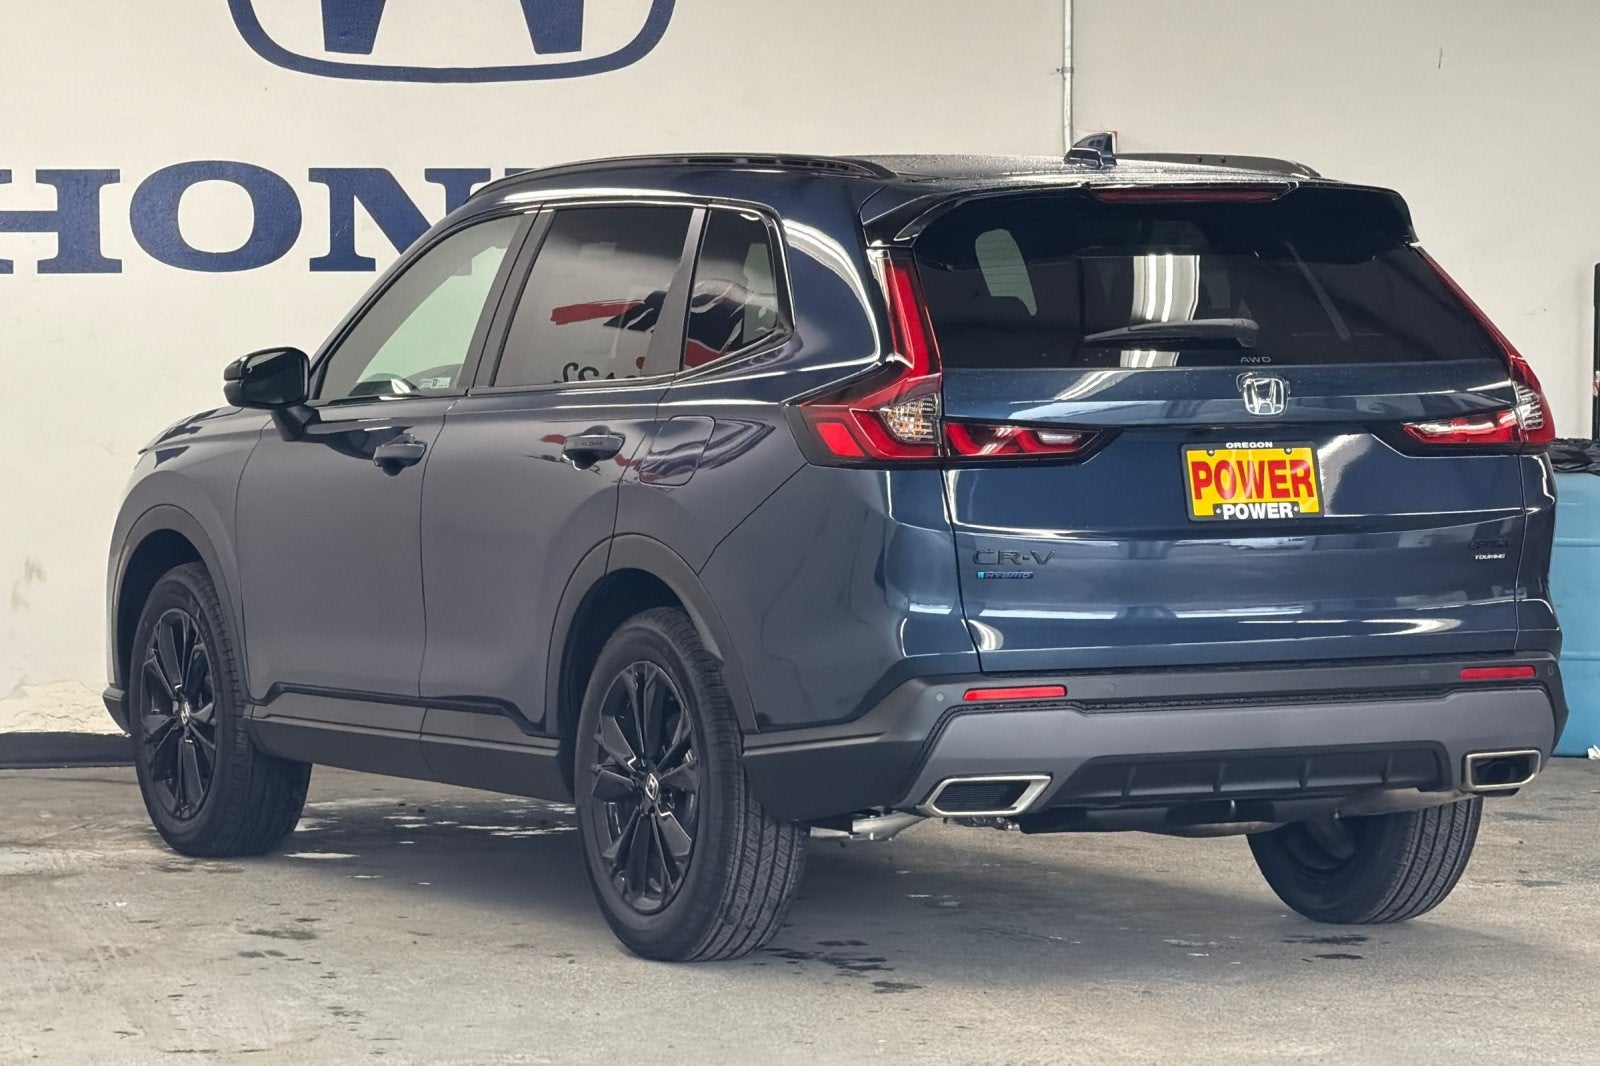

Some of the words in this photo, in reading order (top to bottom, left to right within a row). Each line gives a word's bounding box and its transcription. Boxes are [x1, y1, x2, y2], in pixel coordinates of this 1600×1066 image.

[0, 160, 550, 273] HON
[1225, 441, 1273, 449] OREGON
[1191, 459, 1315, 500] POWER
[1222, 502, 1294, 520] POWER
[973, 550, 1055, 565] CR-V
